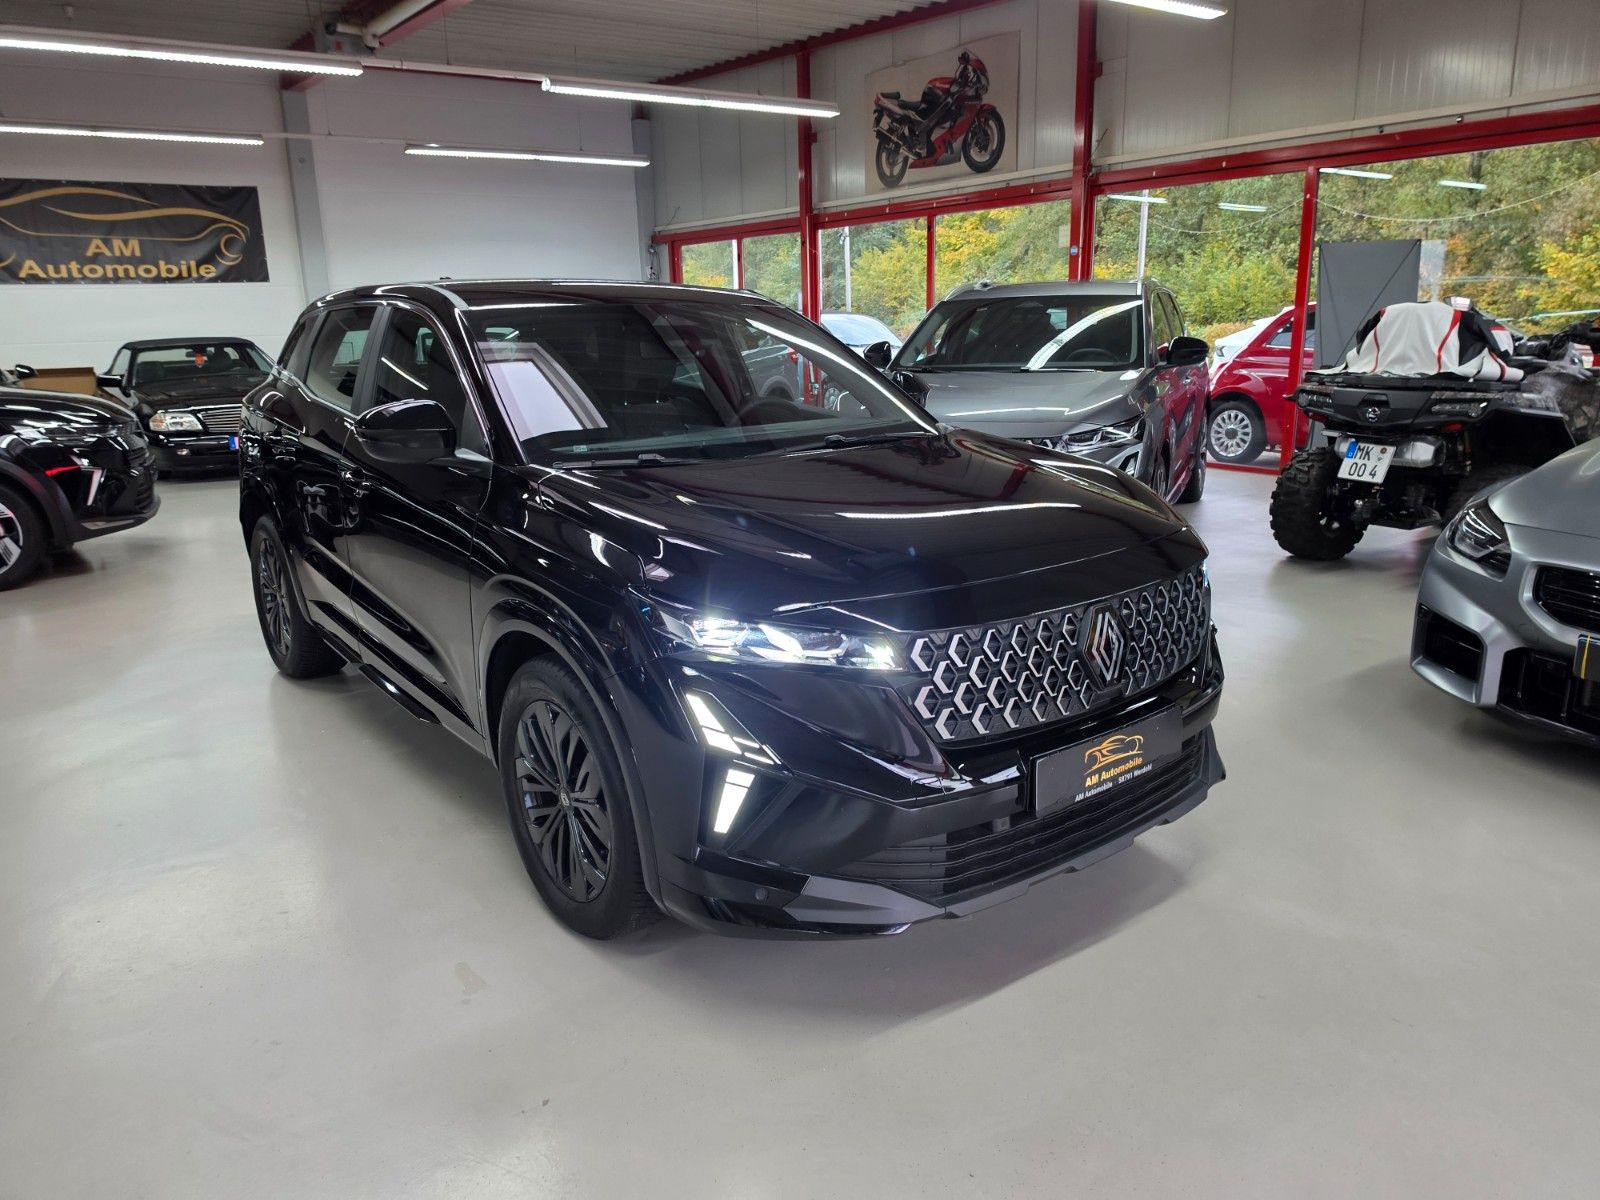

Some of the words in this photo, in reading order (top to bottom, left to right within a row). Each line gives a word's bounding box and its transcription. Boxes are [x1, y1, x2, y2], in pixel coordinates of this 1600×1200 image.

[86, 238, 141, 257] AM
[18, 259, 217, 279] Automobile
[1354, 444, 1374, 461] MK
[1085, 773, 1099, 787] AM
[1100, 757, 1143, 781] Automobile
[1075, 792, 1084, 802] AM
